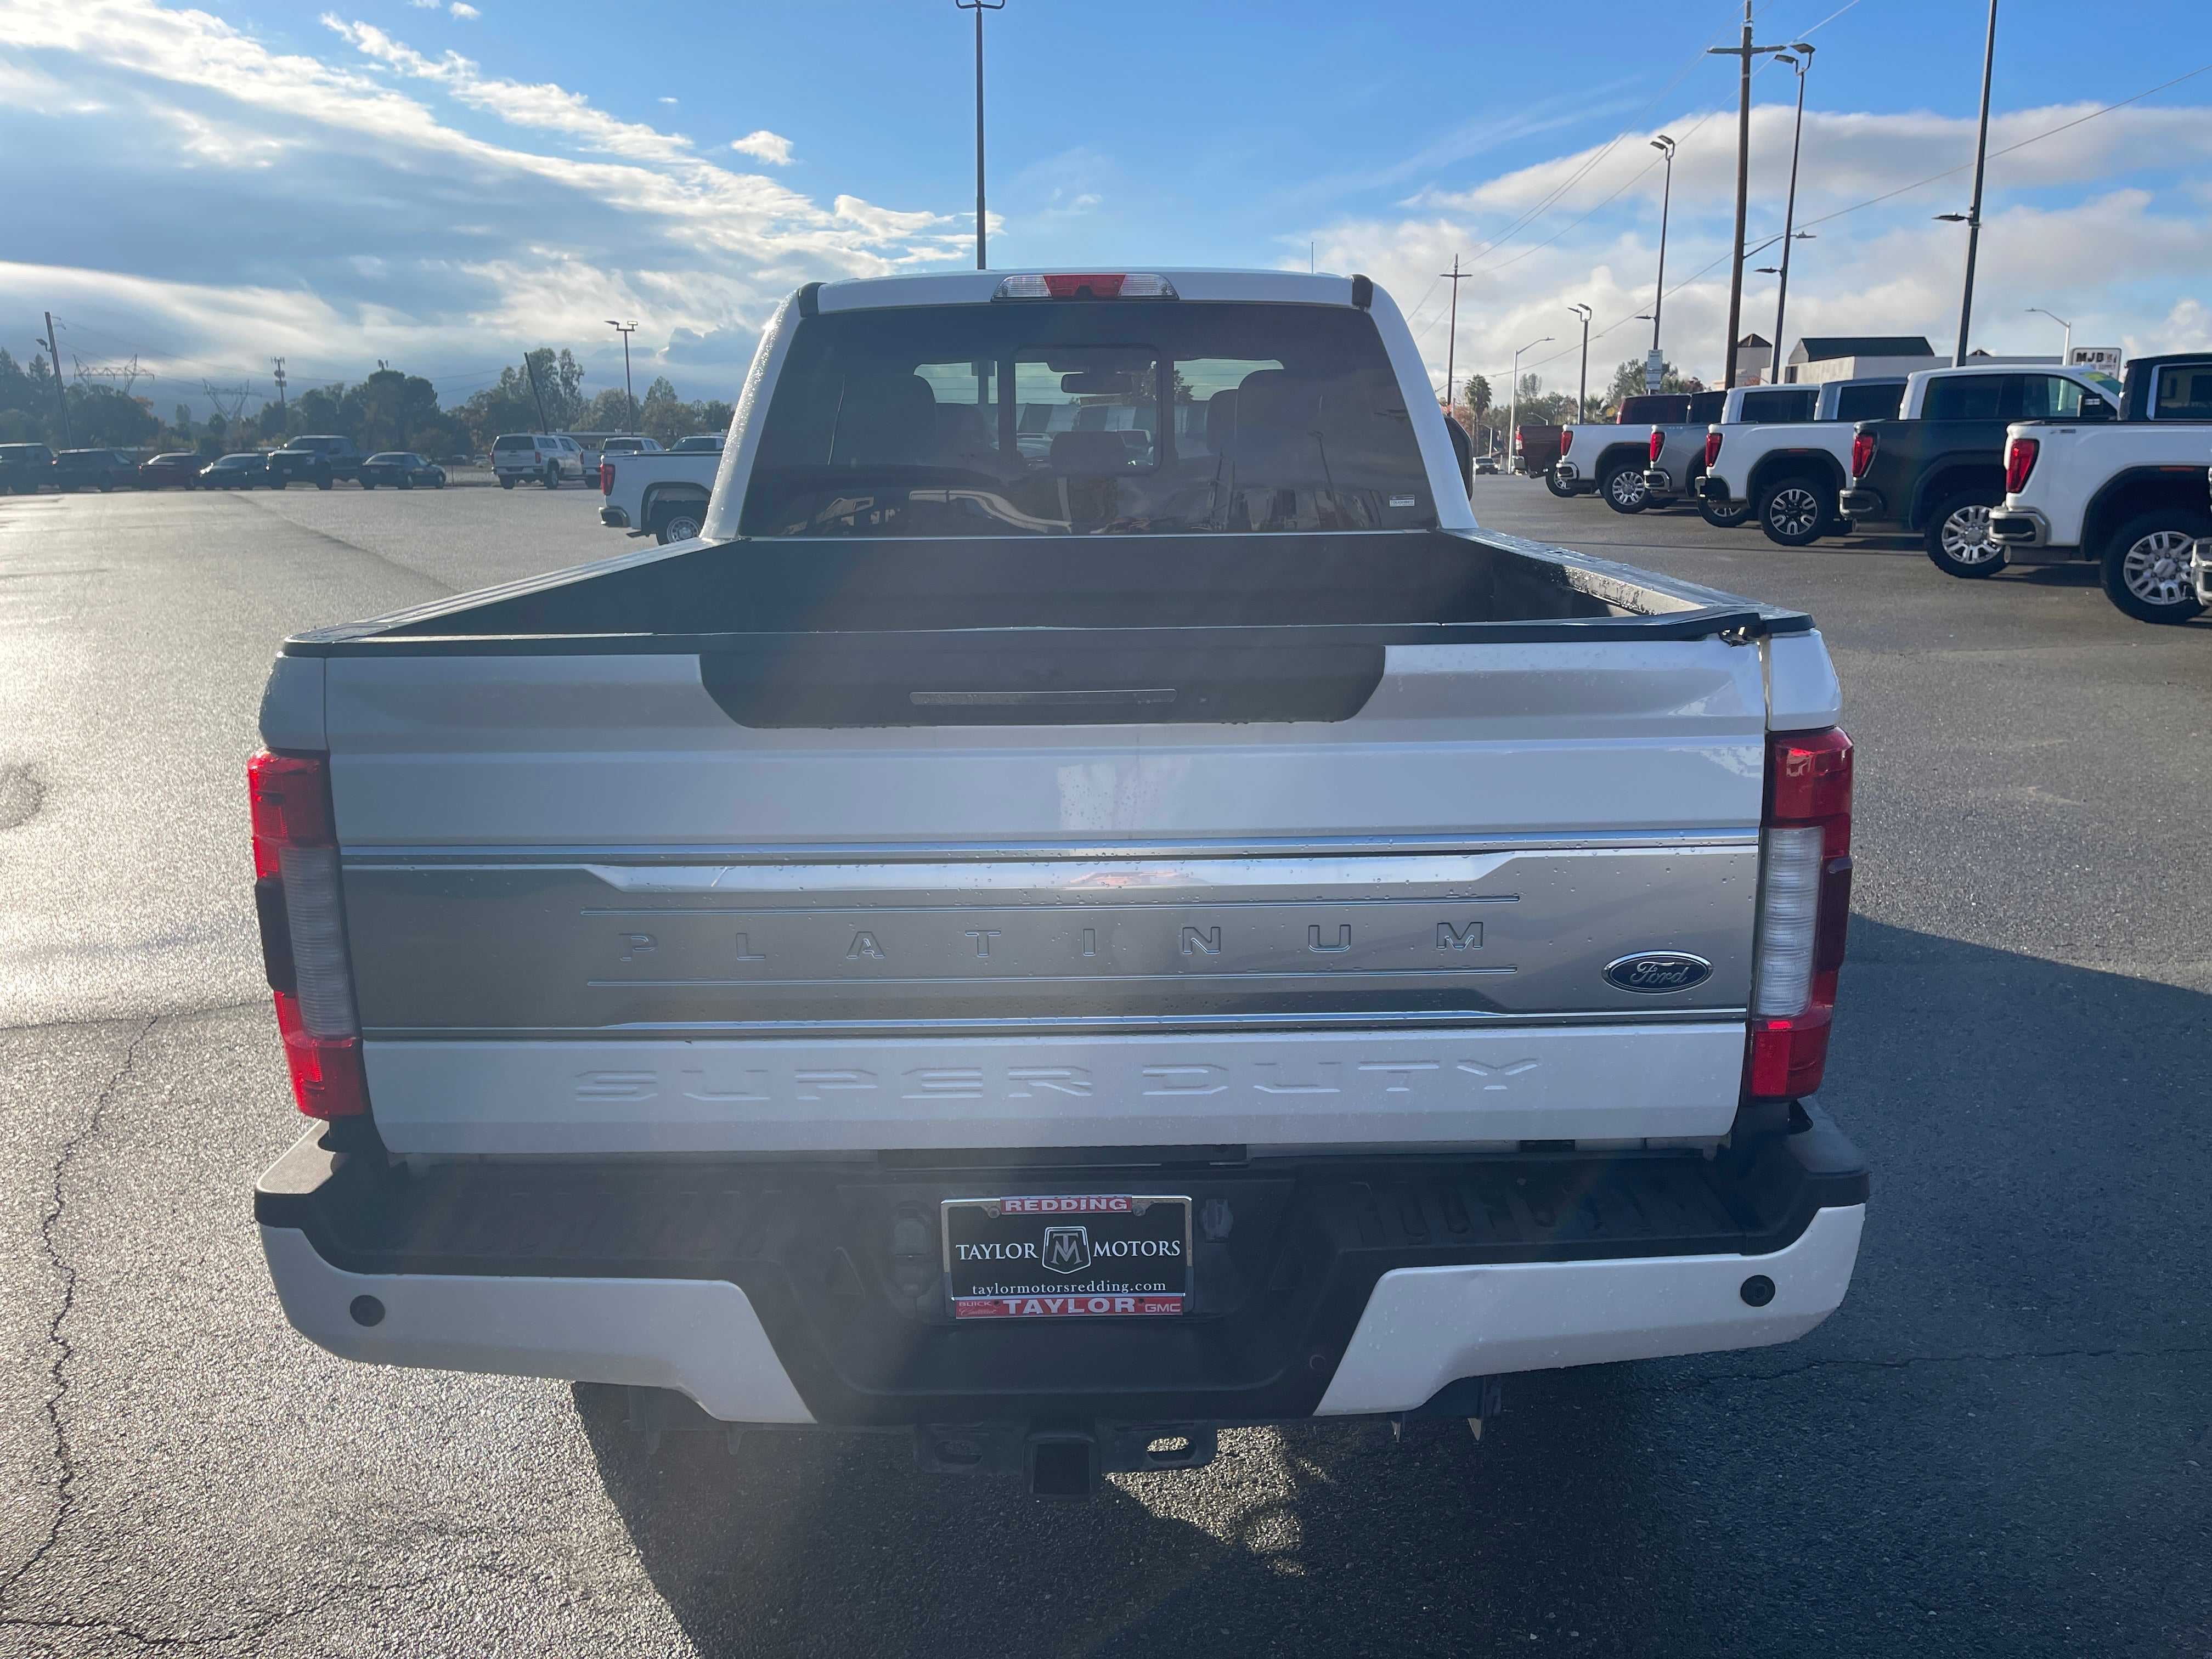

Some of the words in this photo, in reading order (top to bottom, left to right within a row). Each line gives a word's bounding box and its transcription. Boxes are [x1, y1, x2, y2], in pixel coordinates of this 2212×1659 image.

[618, 922, 1484, 961] PLATINUM
[1629, 961, 1690, 984] Ford
[574, 1066, 1092, 1102] SUPER
[1142, 1058, 1538, 1096] DUTY
[1005, 1198, 1128, 1212] REDDING
[955, 1243, 1040, 1261] TAYLOR
[1093, 1240, 1181, 1257] MOTORS
[972, 1280, 1167, 1296] taylormotorsredding.com
[1003, 1297, 1136, 1314] TAYLOR
[1145, 1303, 1181, 1313] GMC
